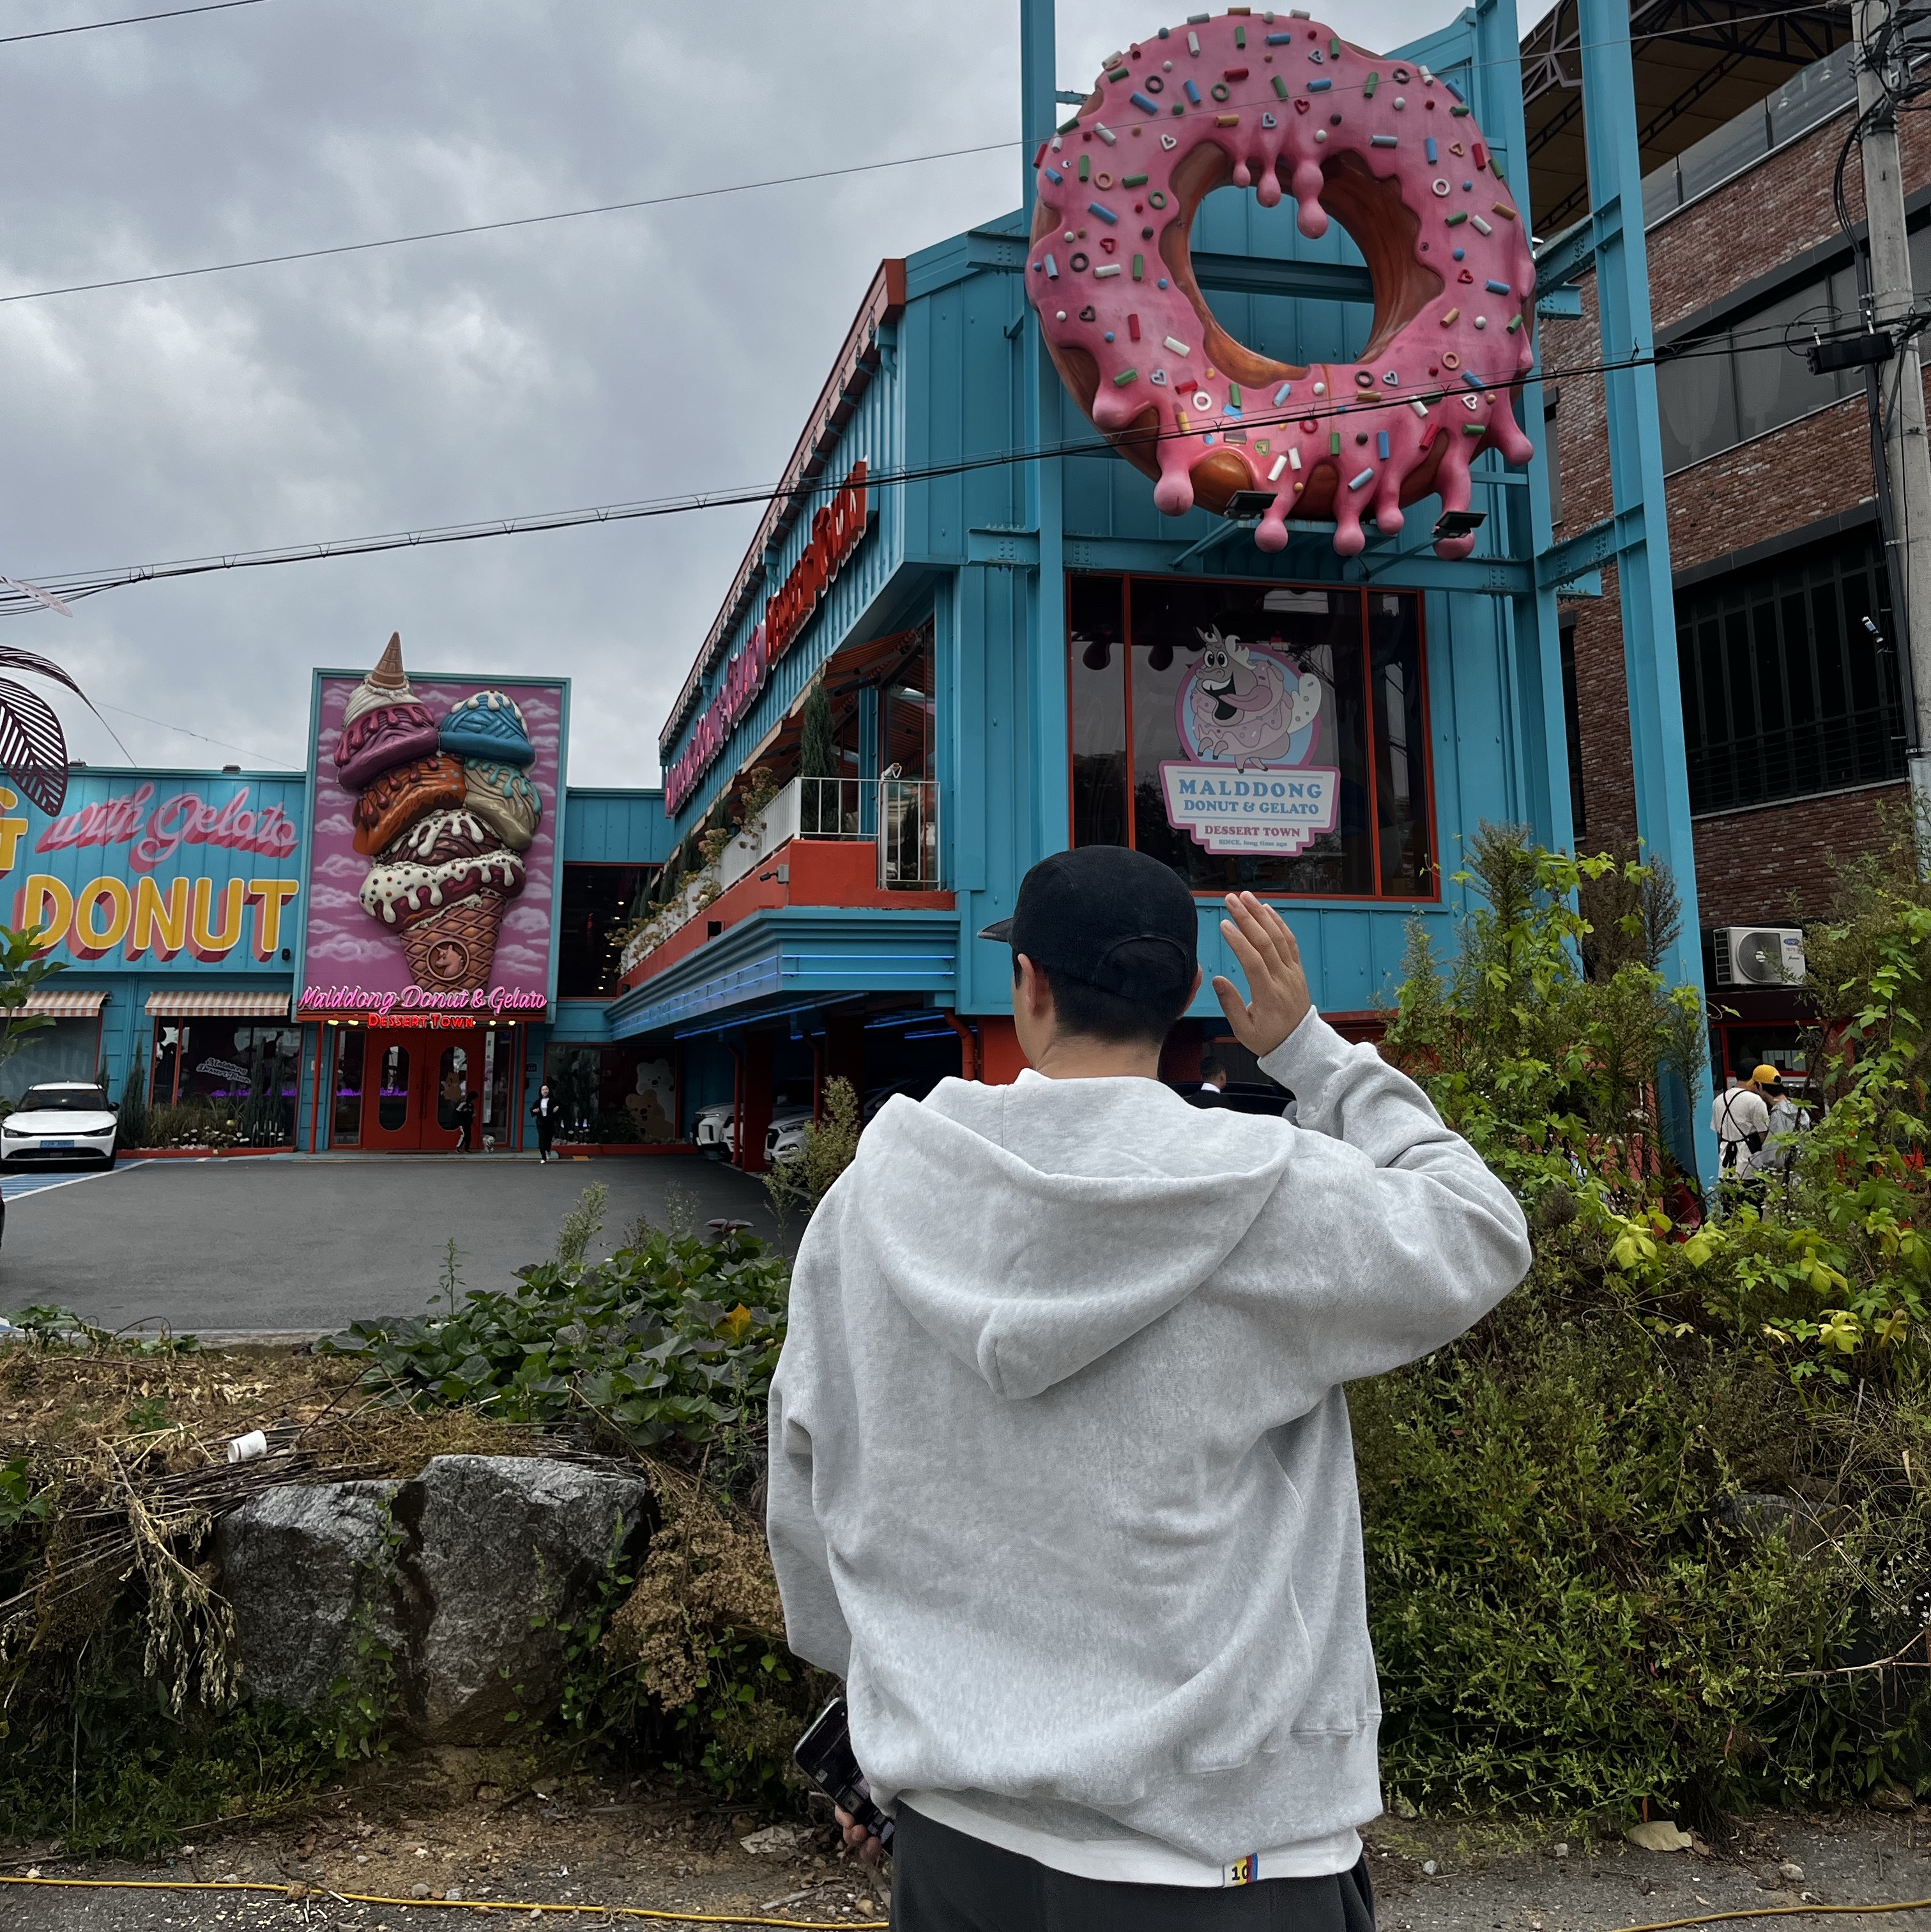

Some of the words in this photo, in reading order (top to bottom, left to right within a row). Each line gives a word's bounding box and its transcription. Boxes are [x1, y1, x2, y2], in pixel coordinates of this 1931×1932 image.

[1179, 779, 1322, 799] MALDDONG
[1184, 799, 1239, 812] DONUT
[1242, 801, 1255, 813] &
[1258, 802, 1319, 815] GELATO
[48, 781, 155, 847] with
[133, 786, 300, 864] Gelato
[1204, 825, 1260, 836] DESSERT
[1262, 827, 1301, 837] TOWN
[18, 873, 299, 956] DONUT
[297, 986, 399, 1015] Malddong
[401, 985, 470, 1009] Donut
[470, 988, 485, 1008] &
[488, 986, 547, 1015] Gelato
[367, 1012, 429, 1028] DESSERT
[431, 1013, 475, 1029] TOWN
[1232, 1864, 1251, 1880] 10
